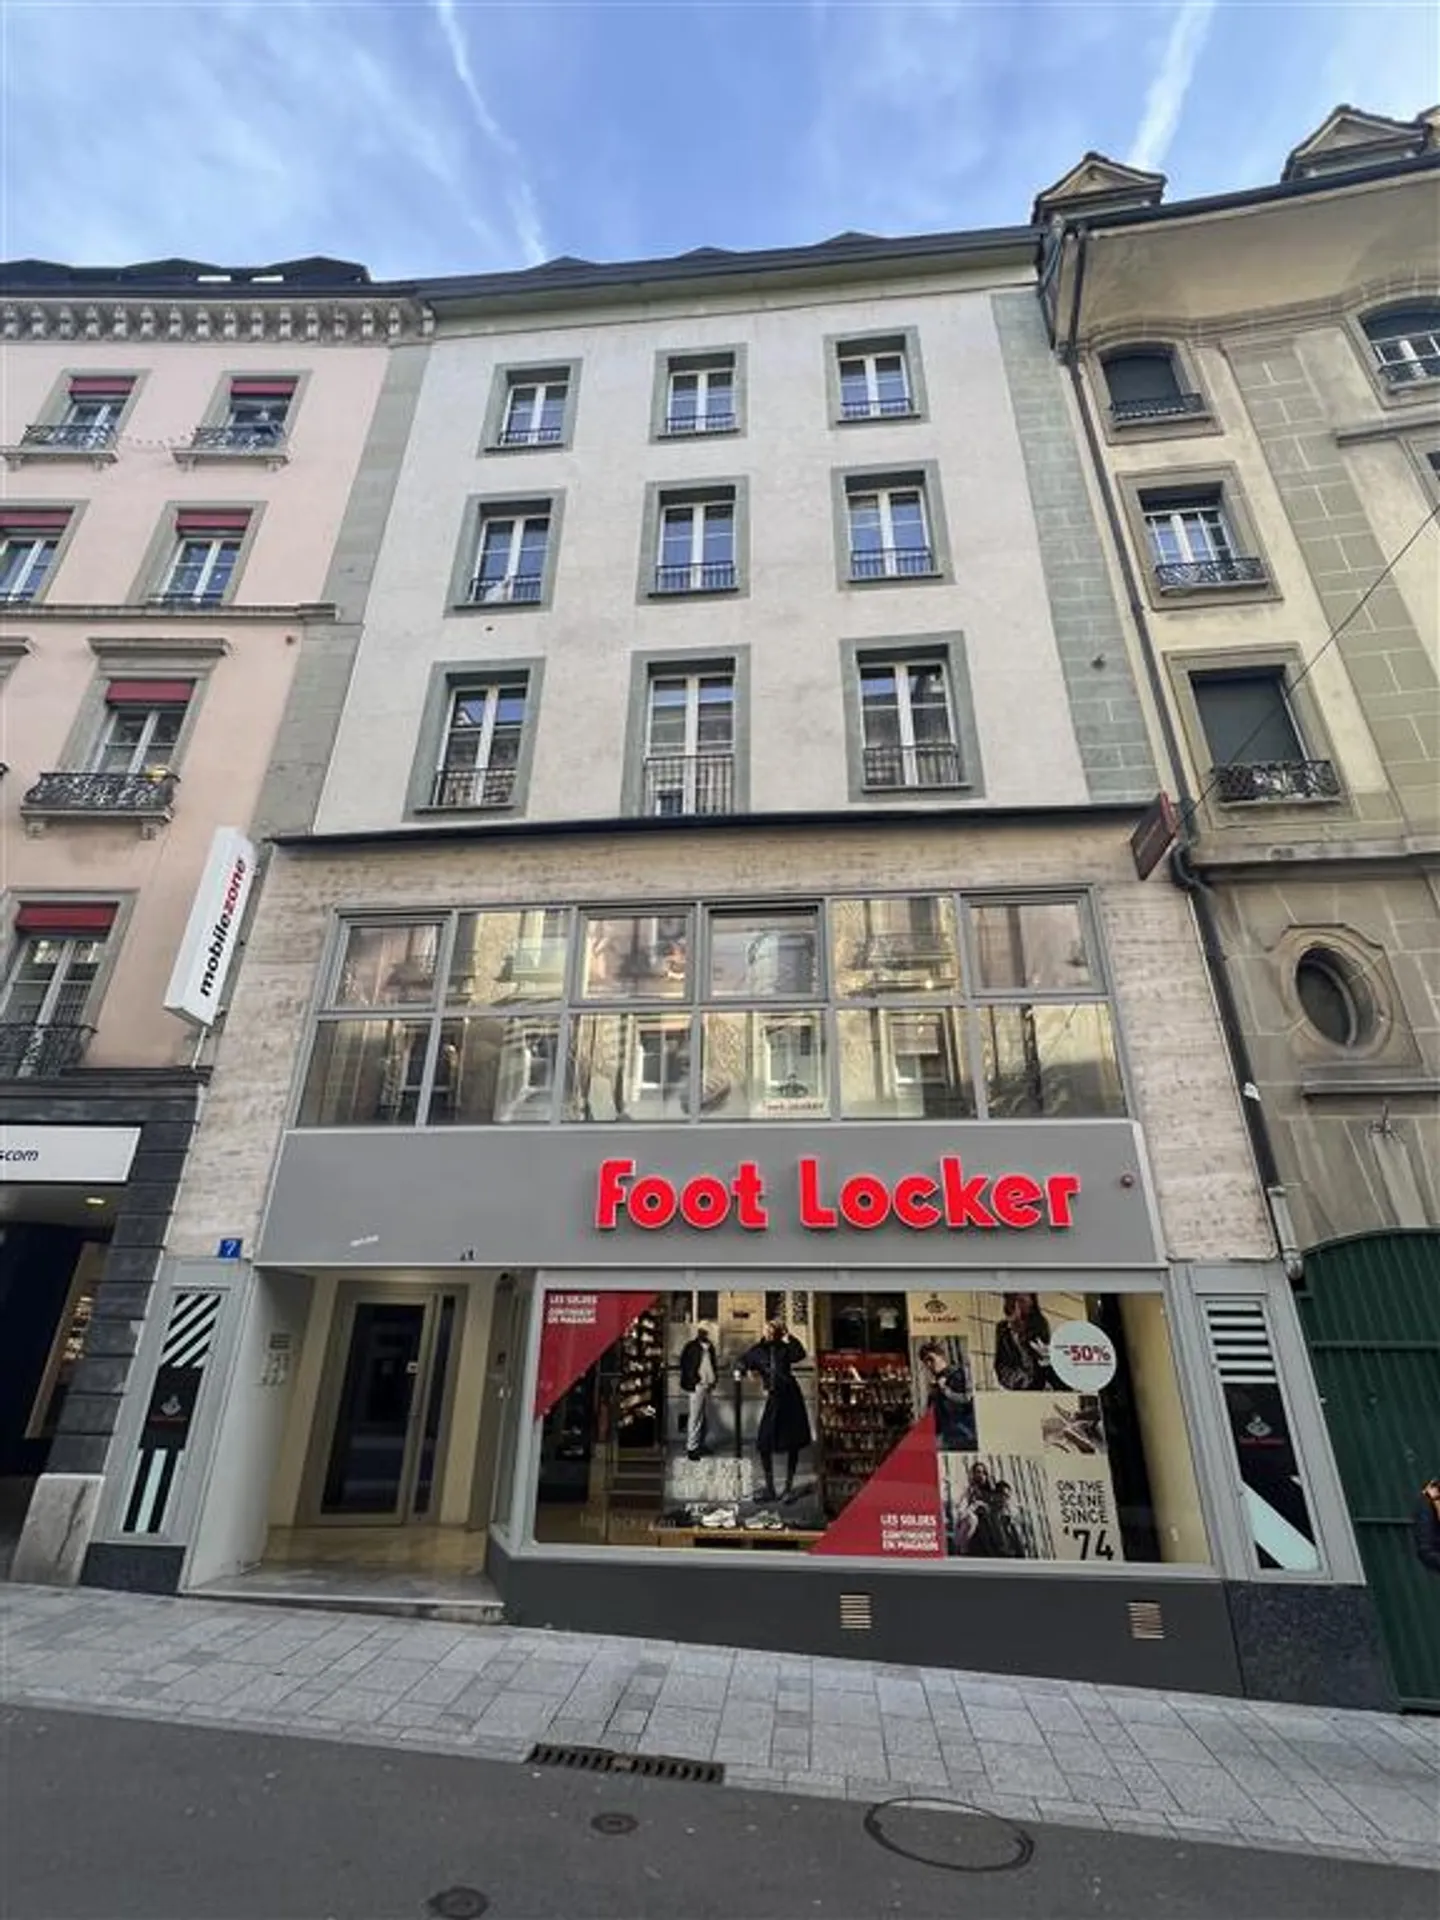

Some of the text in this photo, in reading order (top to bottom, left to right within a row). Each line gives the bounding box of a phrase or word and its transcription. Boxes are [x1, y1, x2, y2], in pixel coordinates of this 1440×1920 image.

[200, 856, 247, 998] mobilezone
[595, 1154, 1080, 1230] Foot Locker
[1063, 1345, 1112, 1361] -50%
[1056, 1479, 1105, 1494] ON THE
[1058, 1492, 1107, 1509] SCENE
[880, 1513, 938, 1527] LES SOLDES
[1060, 1507, 1110, 1524] SINCE
